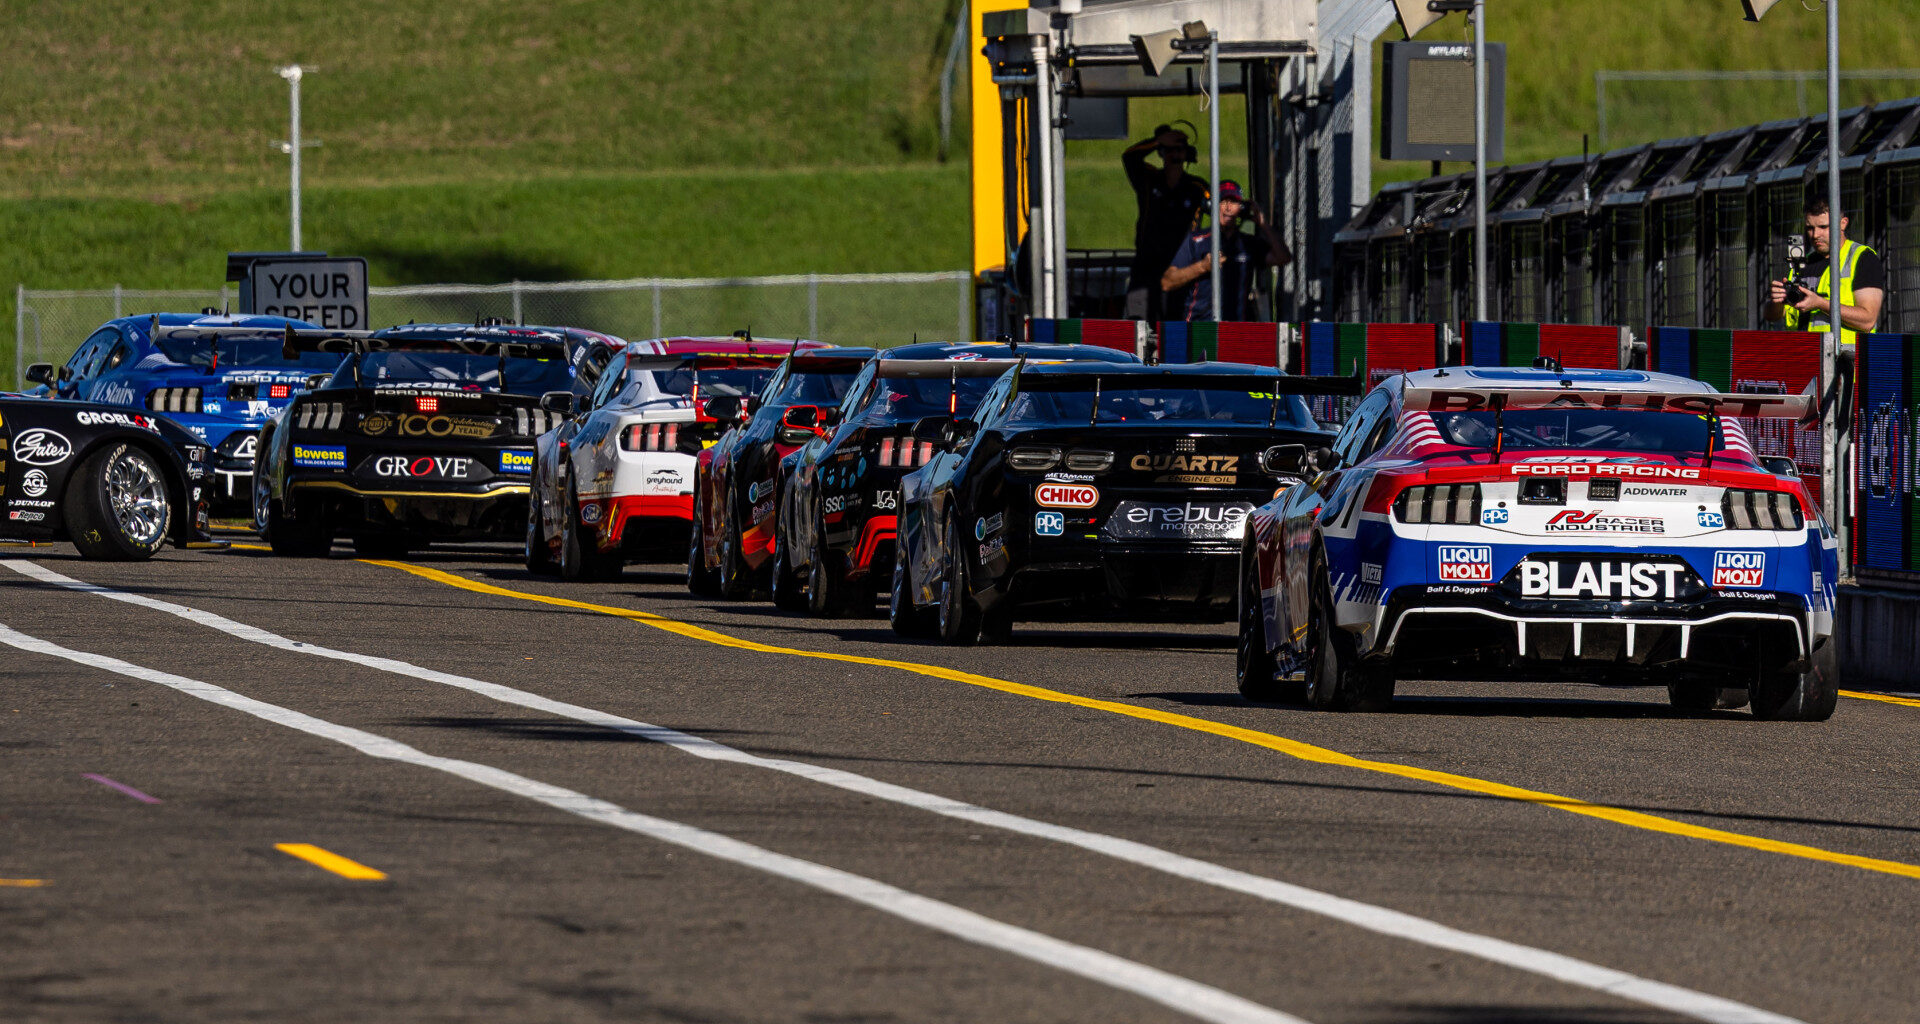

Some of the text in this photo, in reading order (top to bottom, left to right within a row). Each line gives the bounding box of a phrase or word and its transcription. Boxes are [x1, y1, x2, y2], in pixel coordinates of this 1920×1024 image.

[268, 273, 350, 298] YOUR
[421, 390, 482, 399] RACING
[458, 425, 483, 435] YEARS
[16, 433, 68, 461] Gates
[294, 446, 345, 460] Bowens
[502, 452, 533, 465] Bow
[1131, 454, 1239, 472] QUARTZ
[375, 456, 468, 478] GROVE
[1511, 465, 1700, 478] FORD RACING
[646, 476, 683, 485] greyhound
[1045, 472, 1095, 480] METAMARK
[1168, 475, 1210, 483] ENGINE
[22, 478, 48, 488] ACL
[1040, 488, 1093, 503] CHIKO
[1623, 487, 1687, 496] ADDWATER
[825, 495, 844, 513] SSG
[18, 510, 44, 521] Repco
[1127, 502, 1247, 523] erebus
[1483, 510, 1508, 522] PPG
[1037, 515, 1061, 532] PPG
[1595, 517, 1664, 526] RACER
[1700, 513, 1722, 526] PPG
[1545, 524, 1665, 533] INDUSTRIES
[1442, 548, 1488, 563] LIQUI
[1718, 554, 1761, 568] LIQUI
[1443, 564, 1489, 578] MOLY
[1716, 570, 1761, 584] MOLY
[1521, 561, 1685, 598] BLAHST
[1452, 586, 1488, 595] Doggett
[1744, 592, 1776, 600] Doggett
